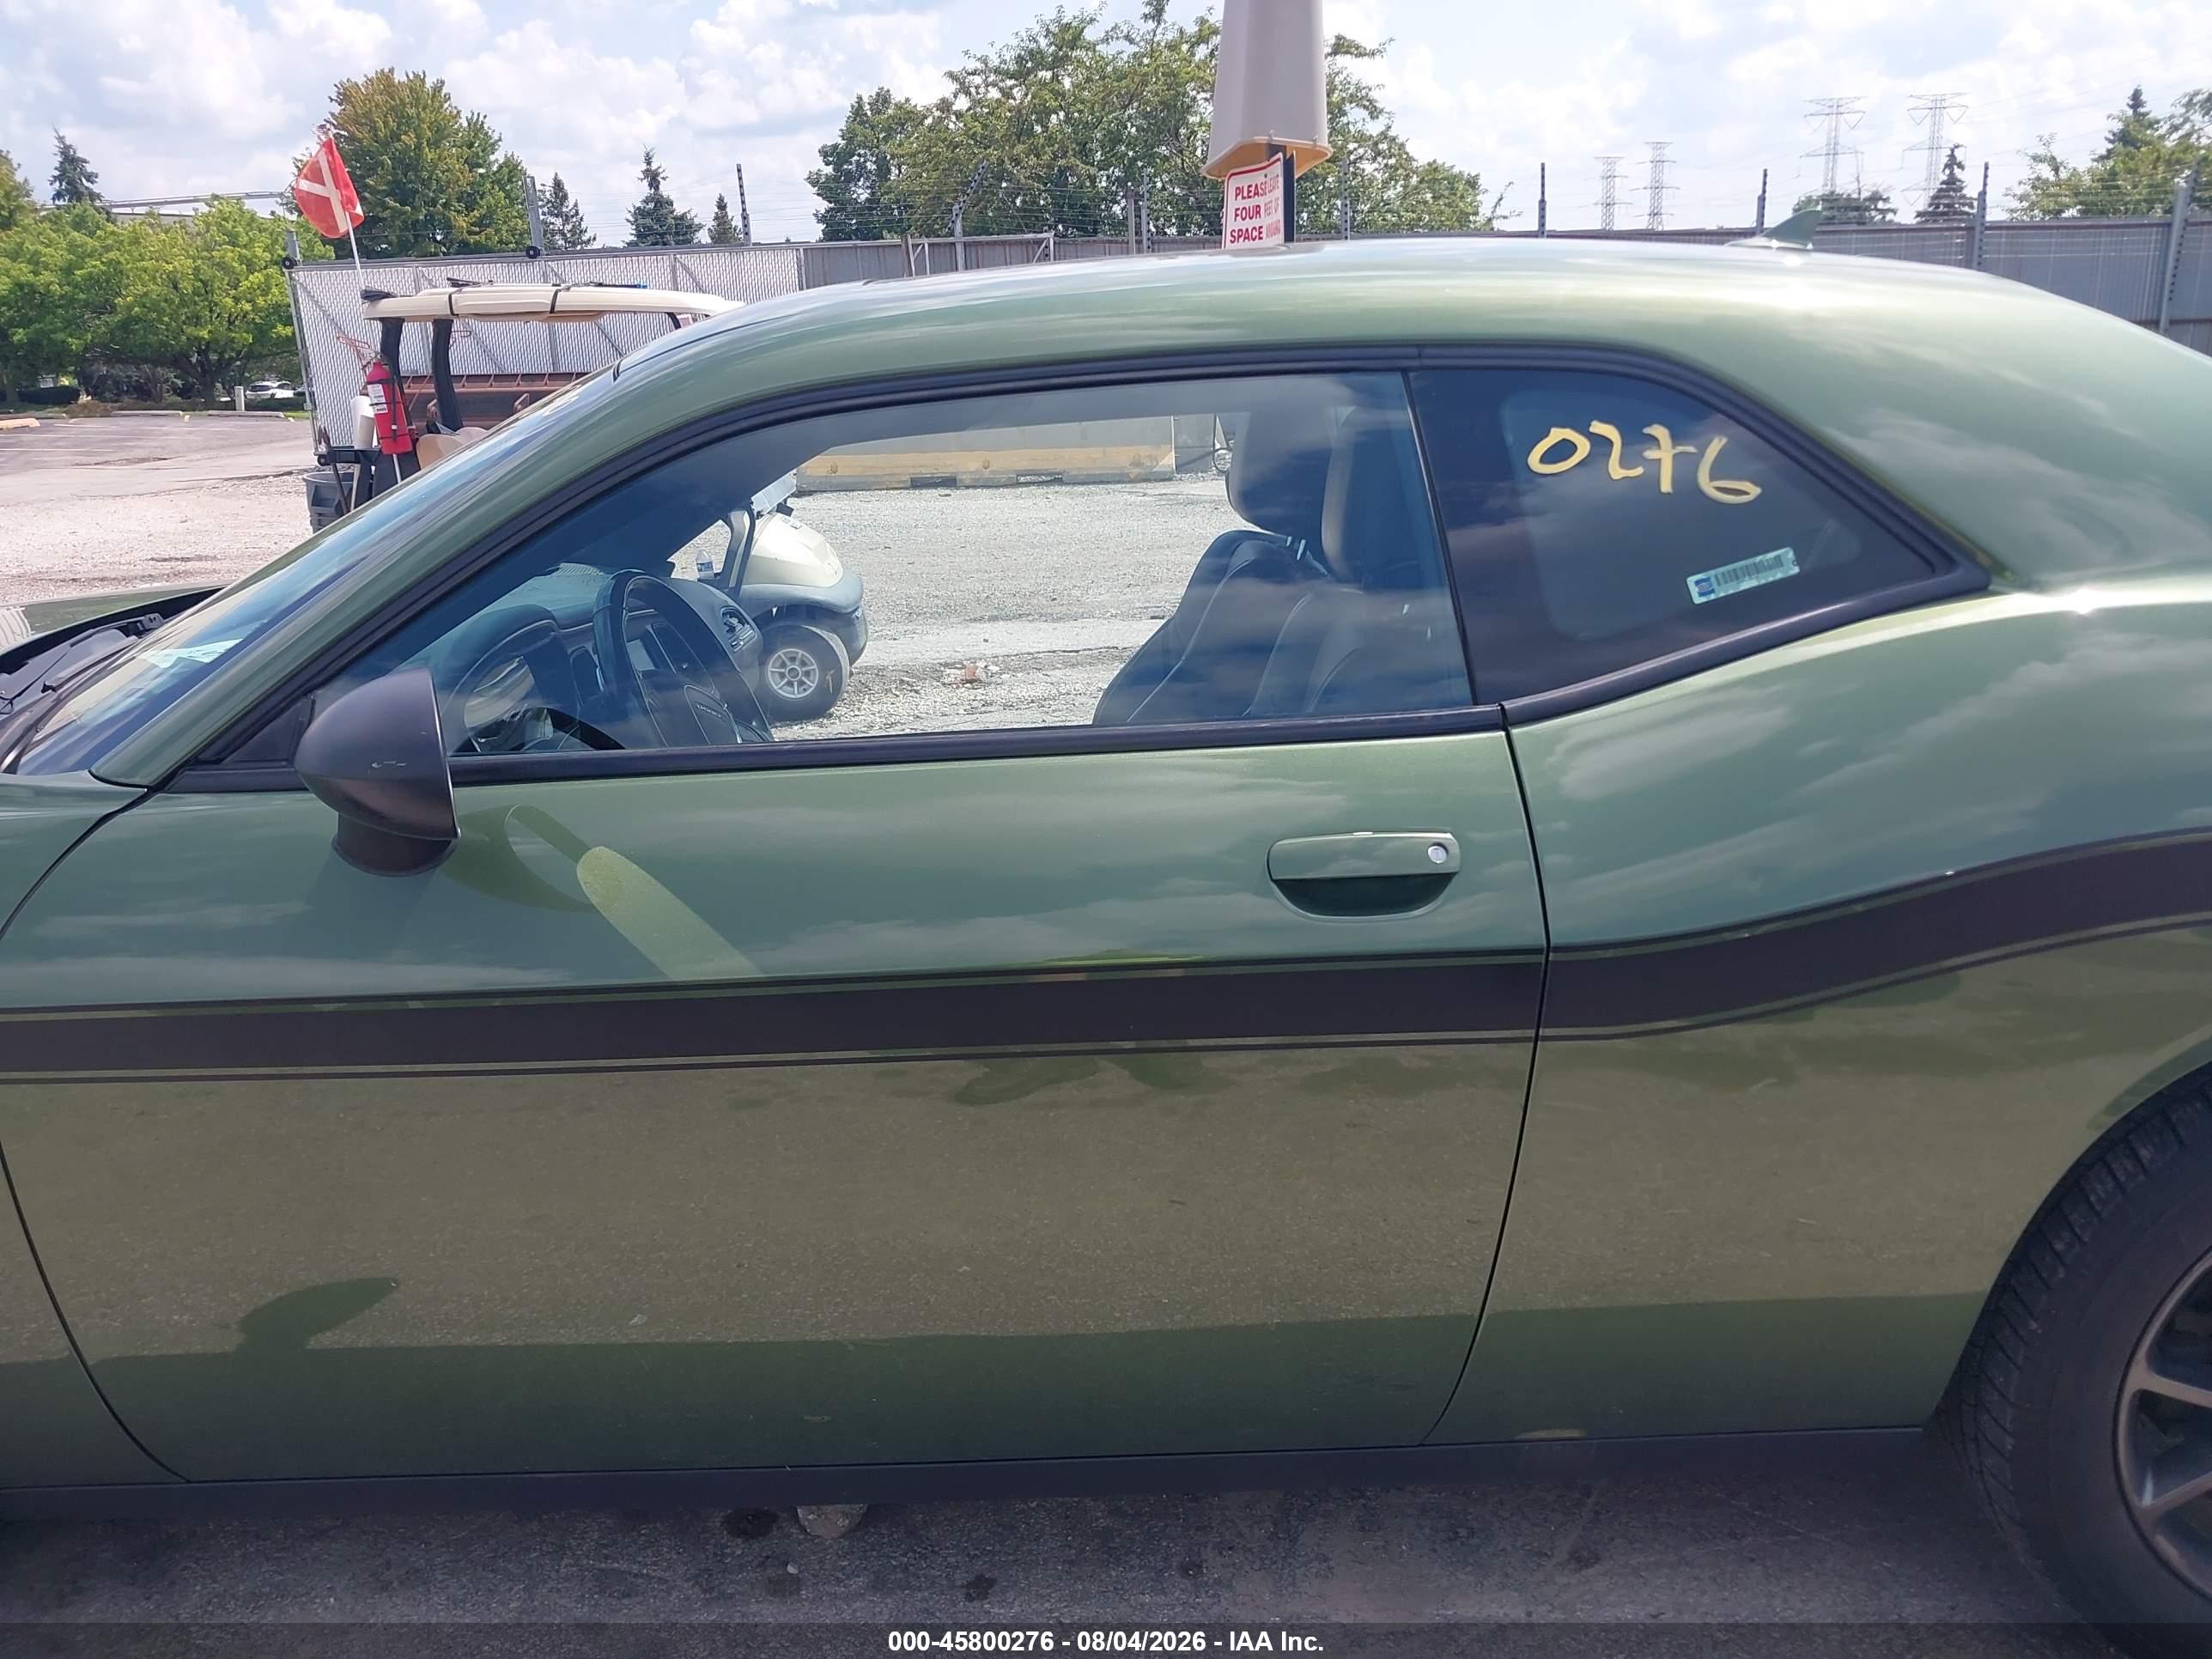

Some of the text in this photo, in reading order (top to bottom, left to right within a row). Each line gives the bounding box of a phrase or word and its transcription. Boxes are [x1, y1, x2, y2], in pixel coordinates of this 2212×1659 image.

[1235, 180, 1267, 201] PLEASE
[1234, 204, 1261, 222] FOUR
[1230, 225, 1263, 244] SPACE
[1527, 420, 1762, 504] 0276
